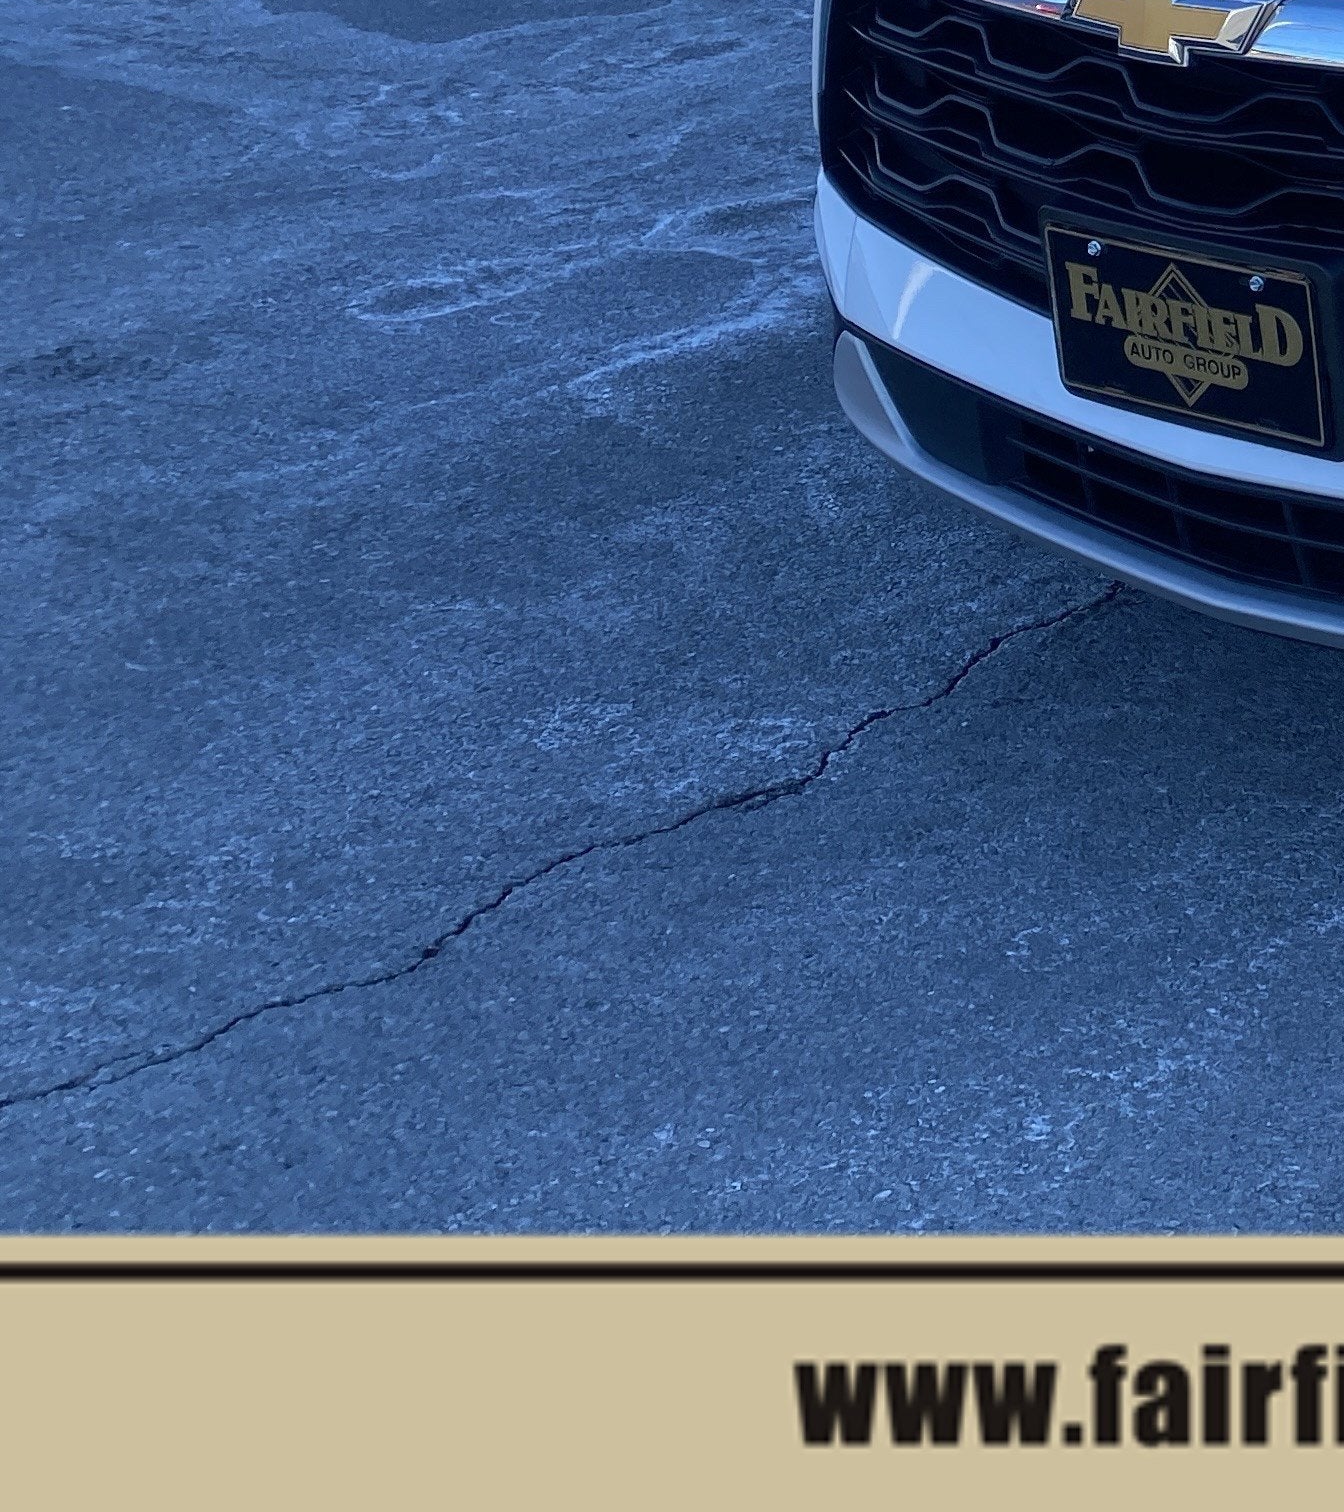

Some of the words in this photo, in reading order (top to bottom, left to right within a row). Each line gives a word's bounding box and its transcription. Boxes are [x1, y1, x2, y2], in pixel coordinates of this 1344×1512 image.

[1064, 260, 1304, 368] FAIRFIELD
[1129, 341, 1175, 366] AUTO
[1182, 353, 1243, 382] GROUP
